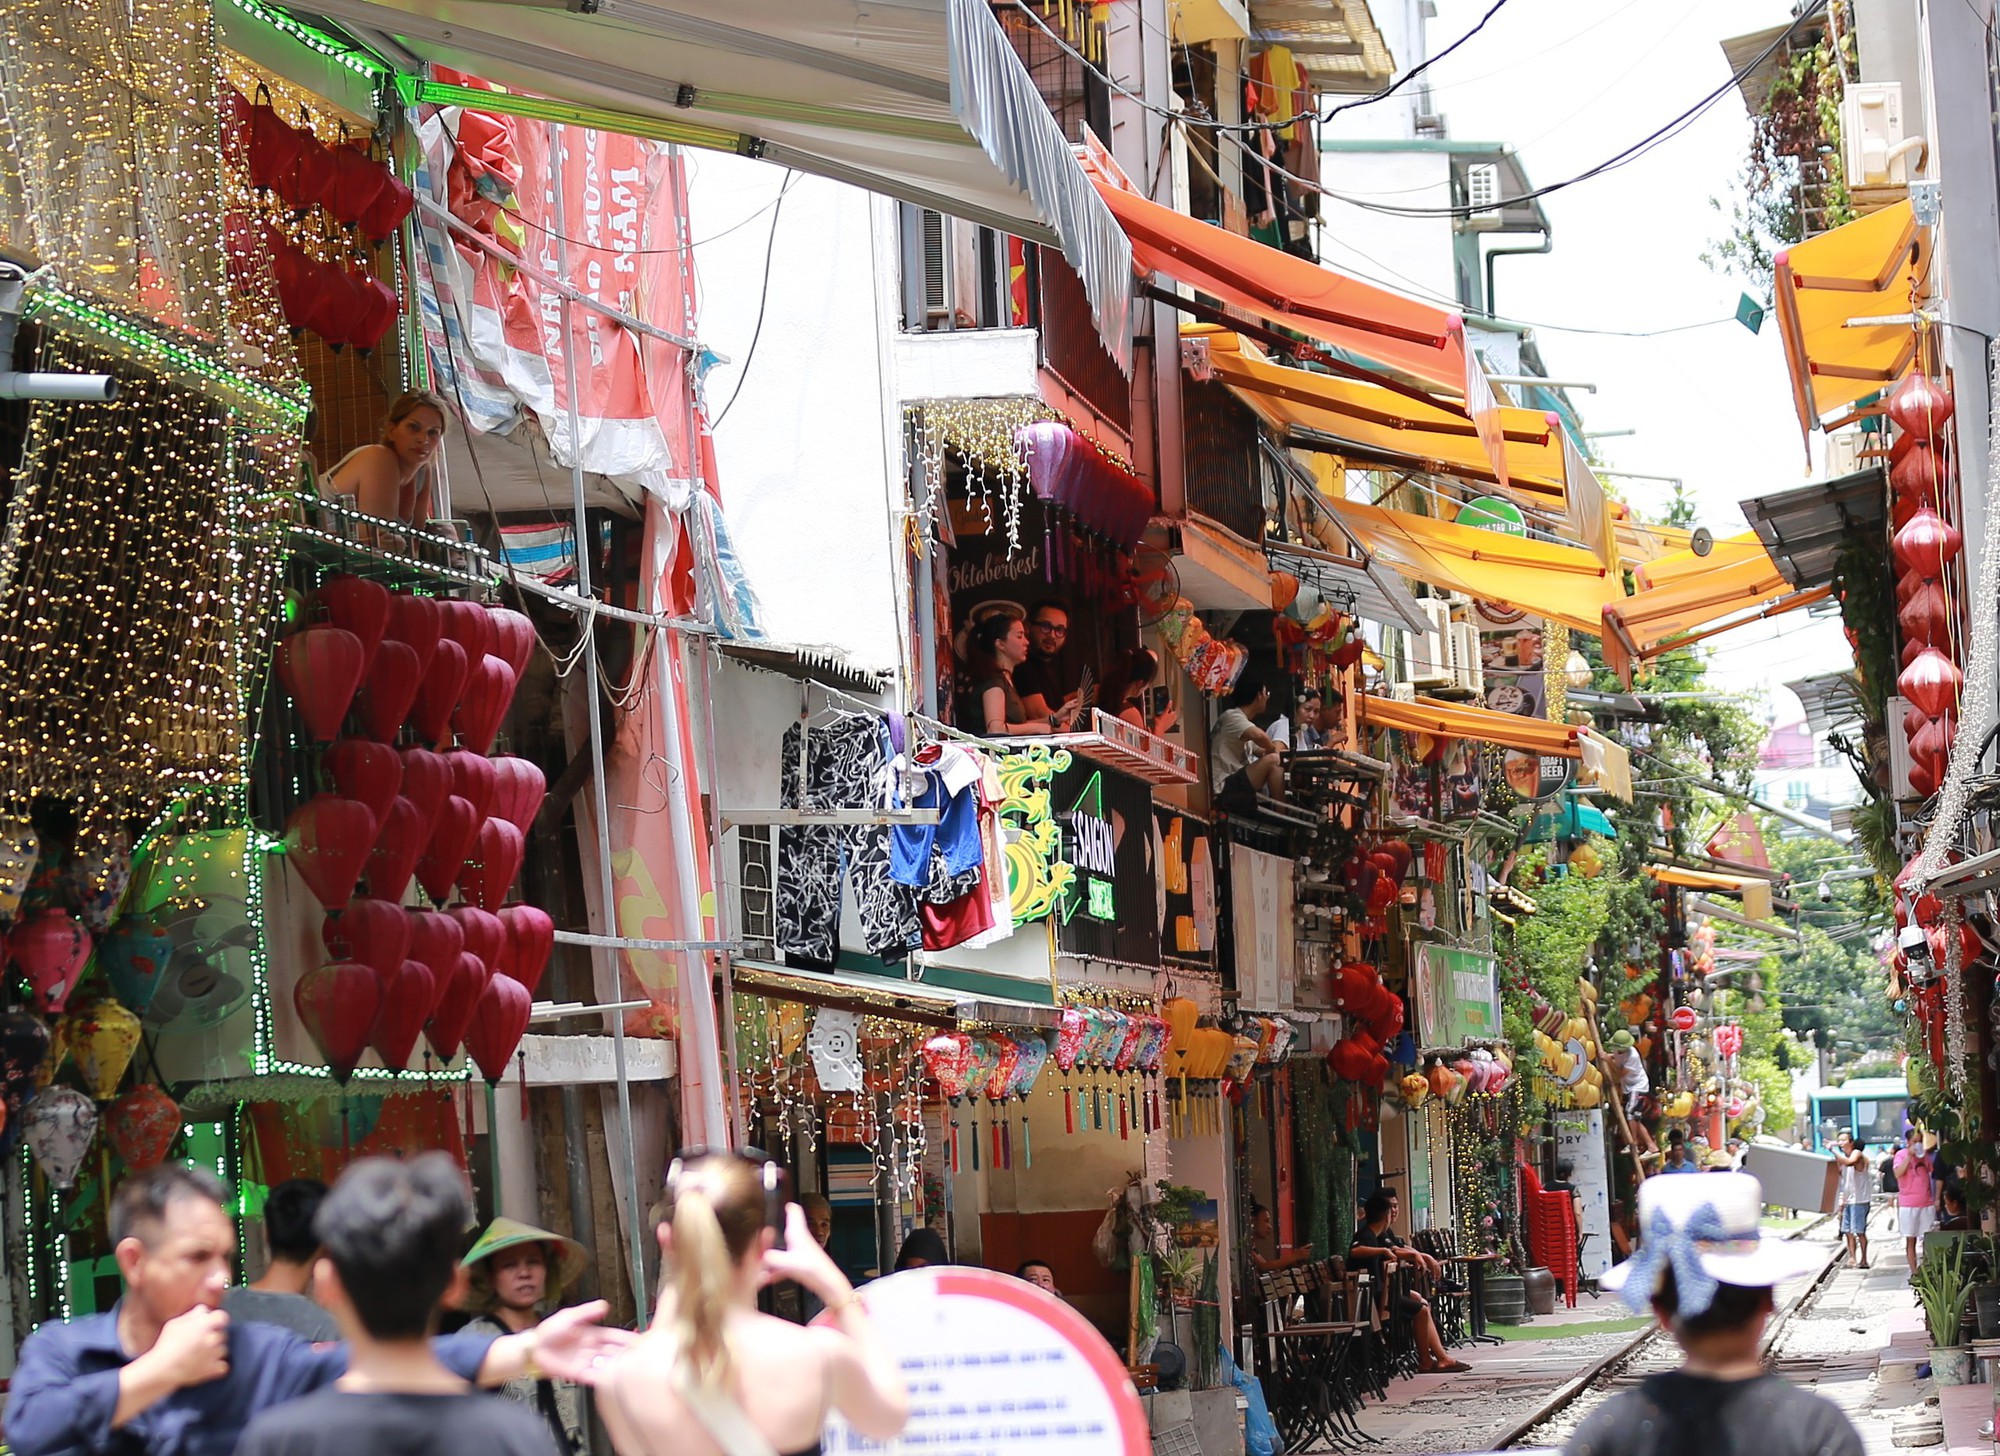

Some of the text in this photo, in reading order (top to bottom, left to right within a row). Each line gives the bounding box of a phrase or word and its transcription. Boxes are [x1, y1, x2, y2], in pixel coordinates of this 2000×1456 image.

[948, 546, 1039, 594] Oktoberfest
[1540, 756, 1563, 766] DRAFT
[1540, 766, 1564, 777] BEER
[1076, 810, 1115, 877] SAIGON
